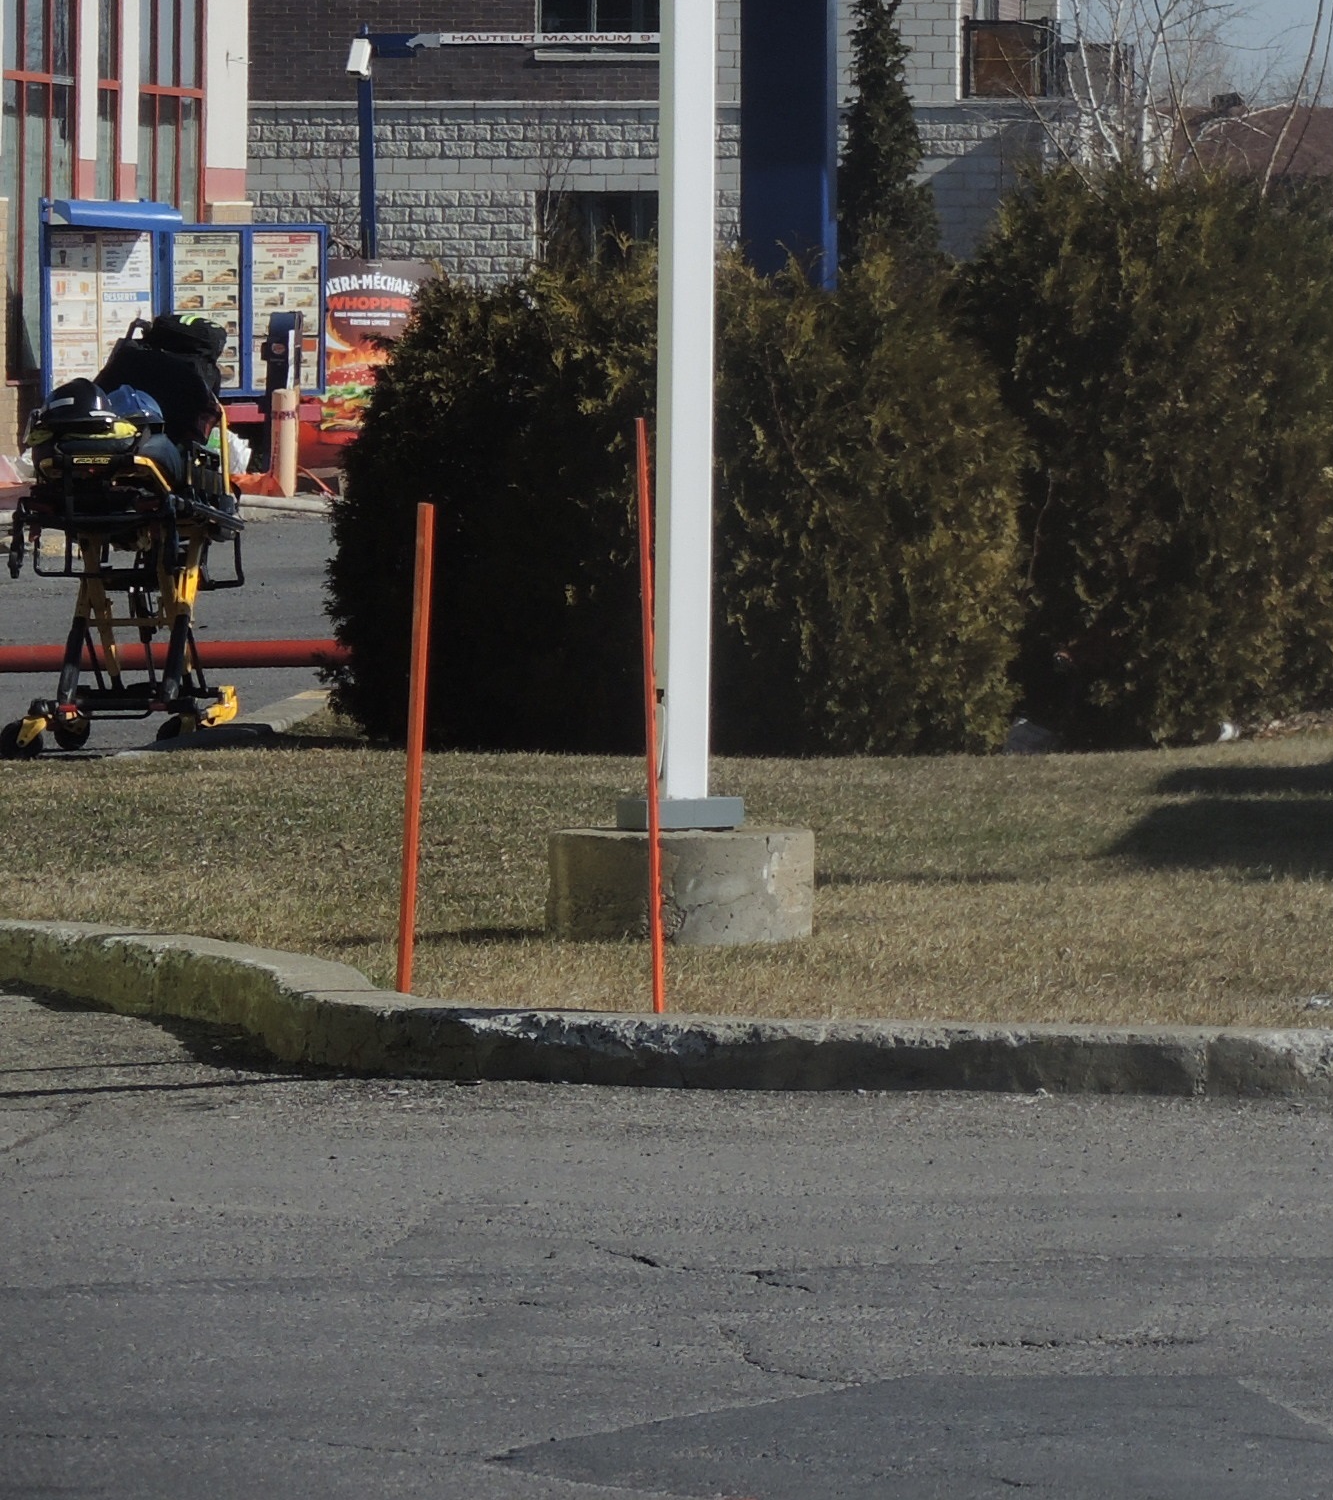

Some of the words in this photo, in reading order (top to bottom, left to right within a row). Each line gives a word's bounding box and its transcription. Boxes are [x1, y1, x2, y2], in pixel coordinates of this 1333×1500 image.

[451, 34, 535, 43] HAUTEUR
[542, 34, 632, 43] MAXIMUM
[103, 292, 138, 302] DESSERTS
